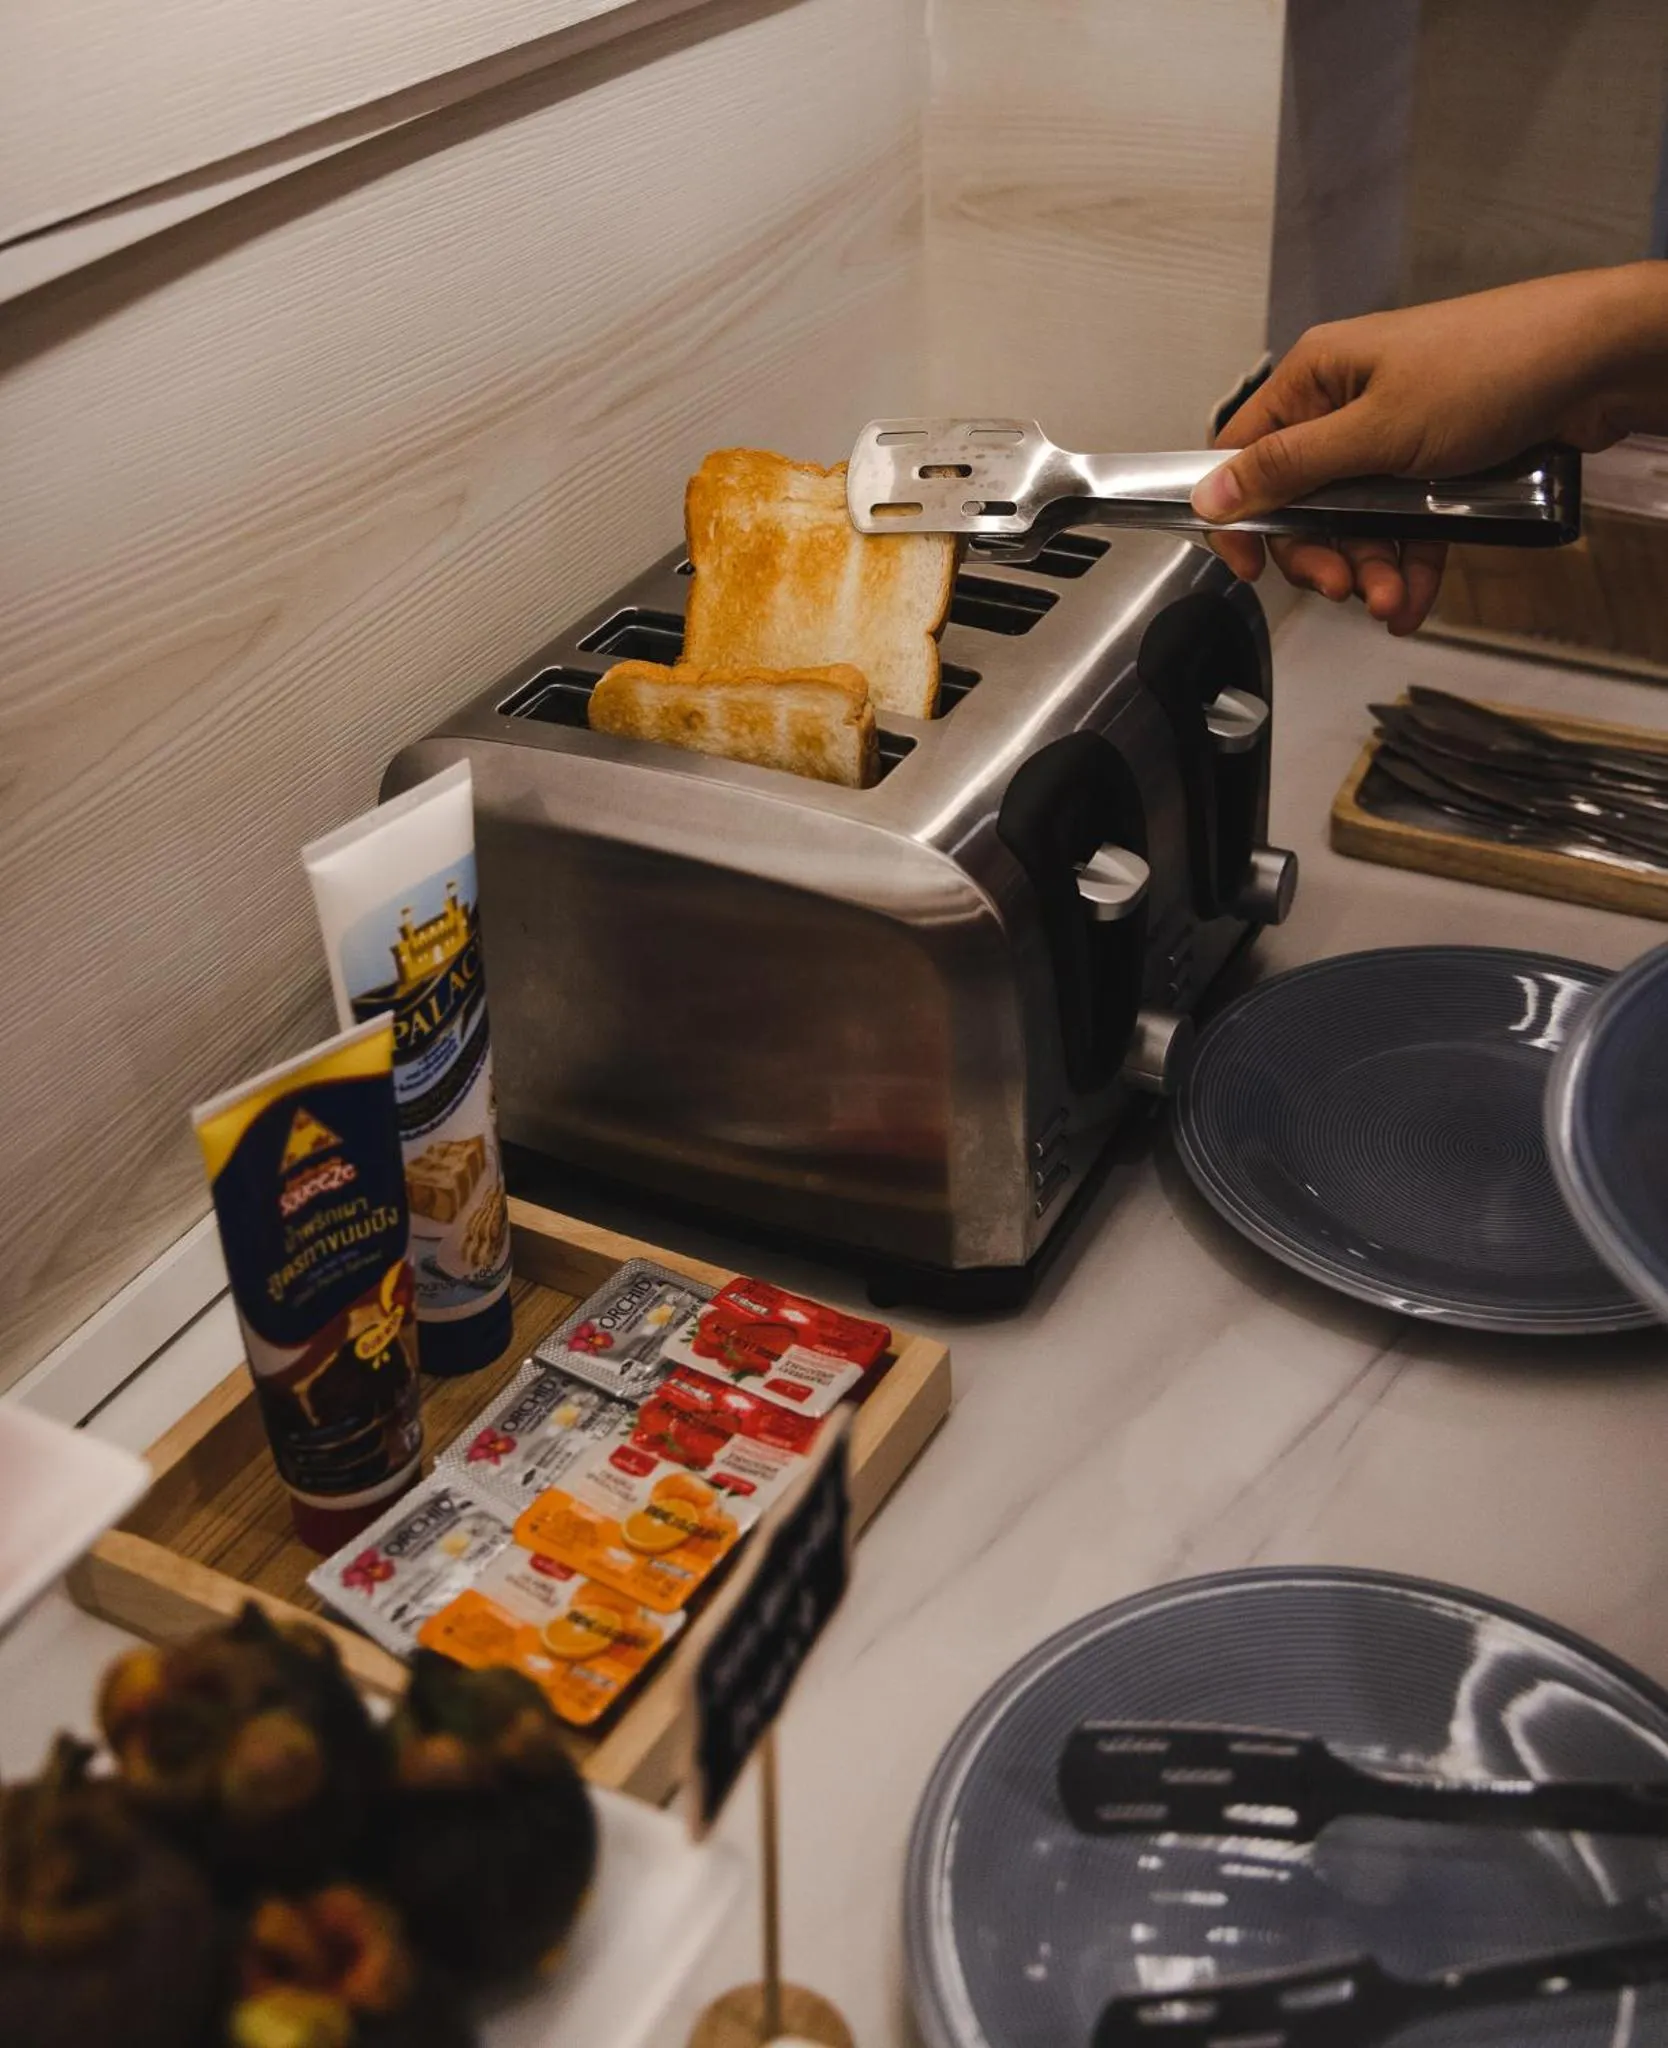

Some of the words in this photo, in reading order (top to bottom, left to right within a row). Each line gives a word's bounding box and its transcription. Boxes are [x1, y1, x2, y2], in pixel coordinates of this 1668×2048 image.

[599, 1278, 653, 1329] ORCHID
[501, 1378, 557, 1433] ORCHID
[384, 1497, 457, 1557] ORCHID
